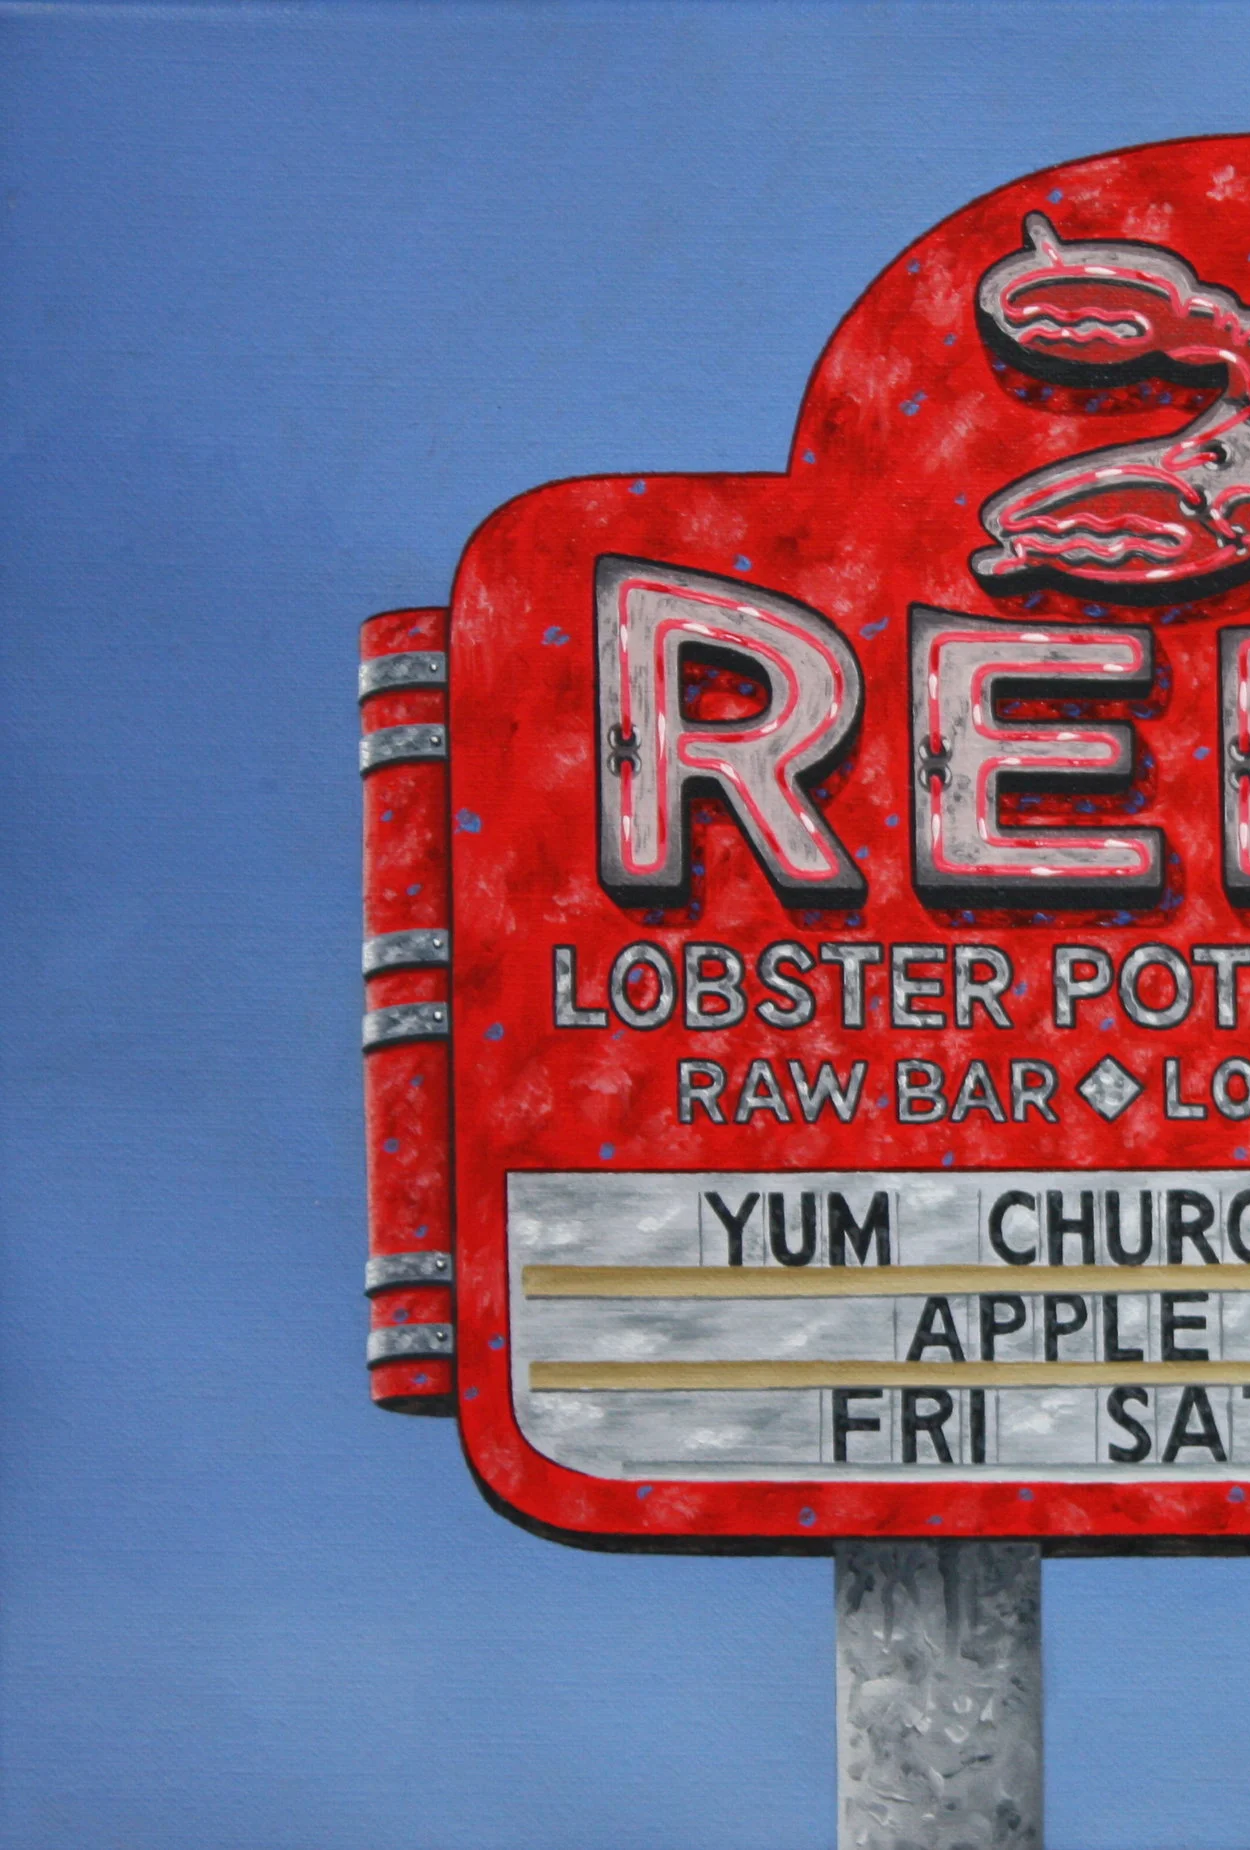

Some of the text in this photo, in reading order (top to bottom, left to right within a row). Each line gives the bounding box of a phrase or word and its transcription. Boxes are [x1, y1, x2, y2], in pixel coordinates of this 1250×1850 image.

[553, 942, 1014, 1030] LOBSTER
[678, 1059, 867, 1125] RAW
[895, 1059, 1059, 1125] BAR
[704, 1189, 890, 1267] YUM
[906, 1293, 1209, 1363] APPLE
[832, 1388, 987, 1464] FRI
